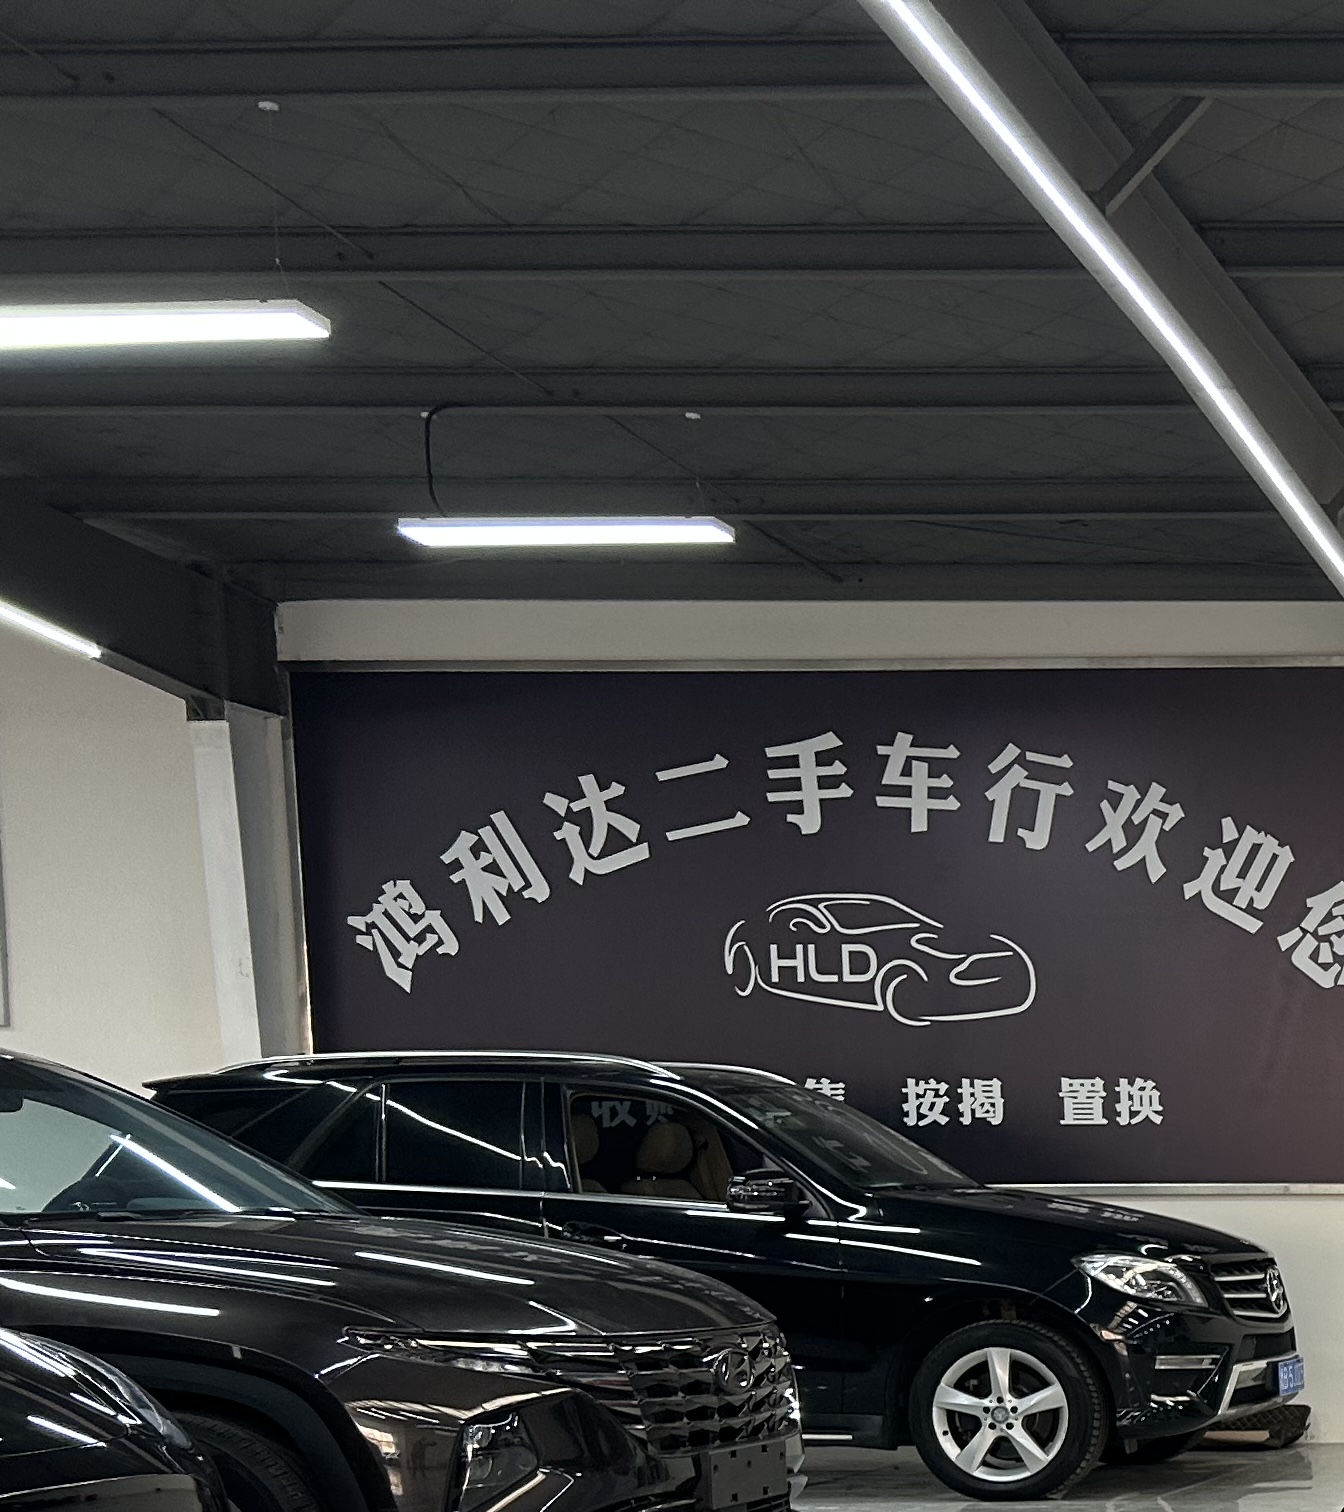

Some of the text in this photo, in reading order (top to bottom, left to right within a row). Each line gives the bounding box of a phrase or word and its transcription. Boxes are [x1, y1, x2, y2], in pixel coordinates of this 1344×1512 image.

[769, 943, 878, 983] HLD
[901, 1076, 1005, 1128] 按揭
[1058, 1076, 1165, 1128] 置换
